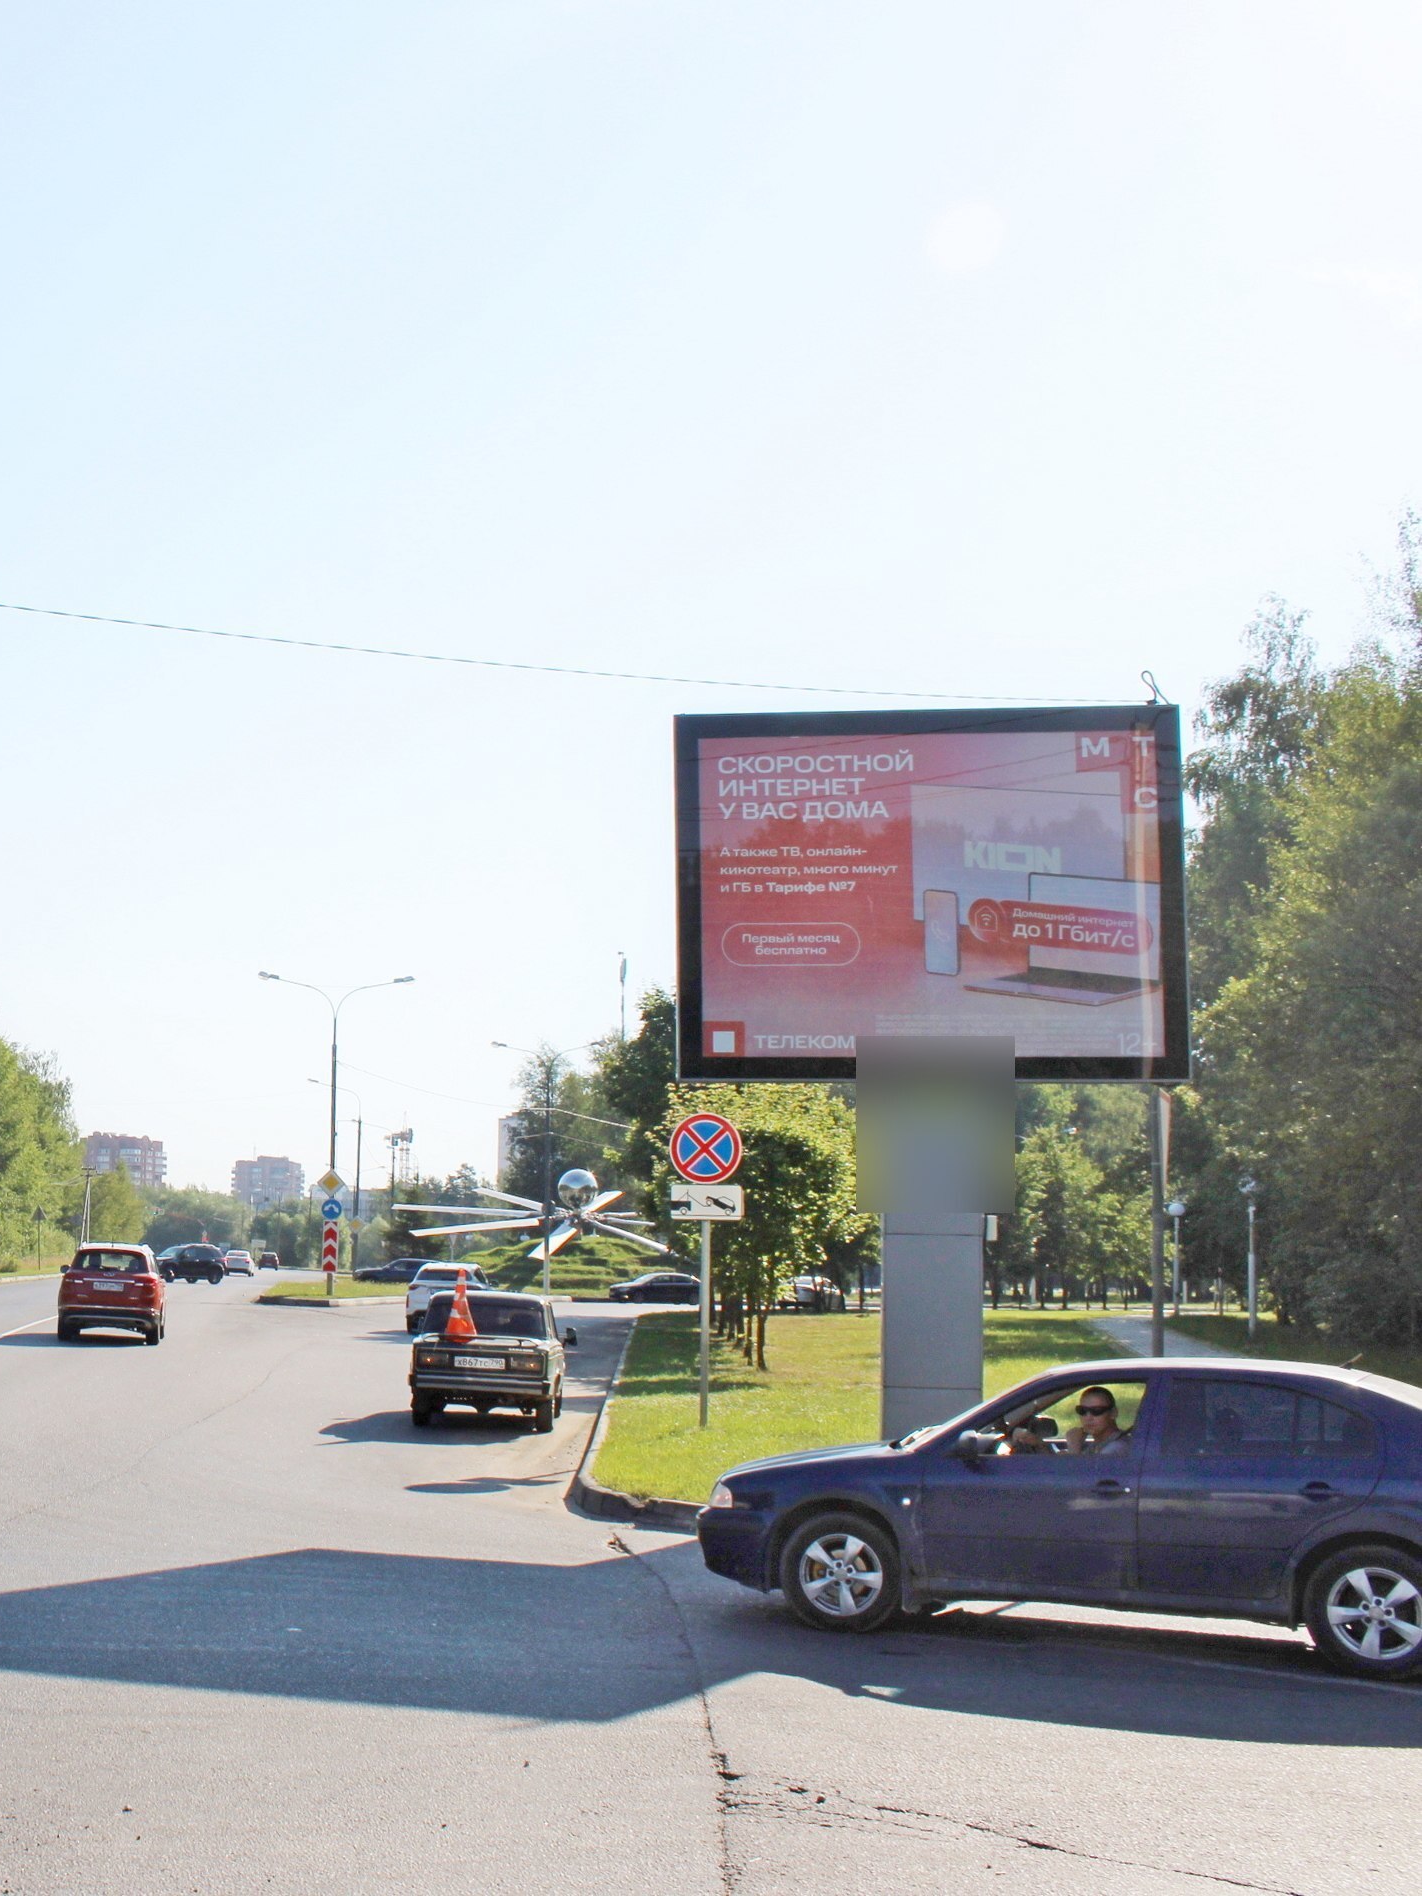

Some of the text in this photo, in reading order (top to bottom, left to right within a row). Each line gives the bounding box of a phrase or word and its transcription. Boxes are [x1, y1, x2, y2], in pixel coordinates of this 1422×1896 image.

[717, 748, 914, 774] СКОРОСТНОЙ
[718, 777, 866, 797] ИНТЕРНЕТ
[718, 801, 889, 823] У ВАС ДОМА
[719, 845, 867, 858] А также ТВ, онлайн-
[963, 840, 1062, 874] KION
[720, 864, 898, 877] кинотеатр, много минут
[720, 881, 856, 895] и ГБ в Тарифе №7
[1012, 908, 1135, 928] Домашний интернет
[742, 932, 841, 946] Первый месяц
[1012, 924, 1136, 948] до 1 Гбит/с
[754, 944, 827, 956] бесплатно
[753, 1035, 855, 1049] ТЕЛЕКОМ
